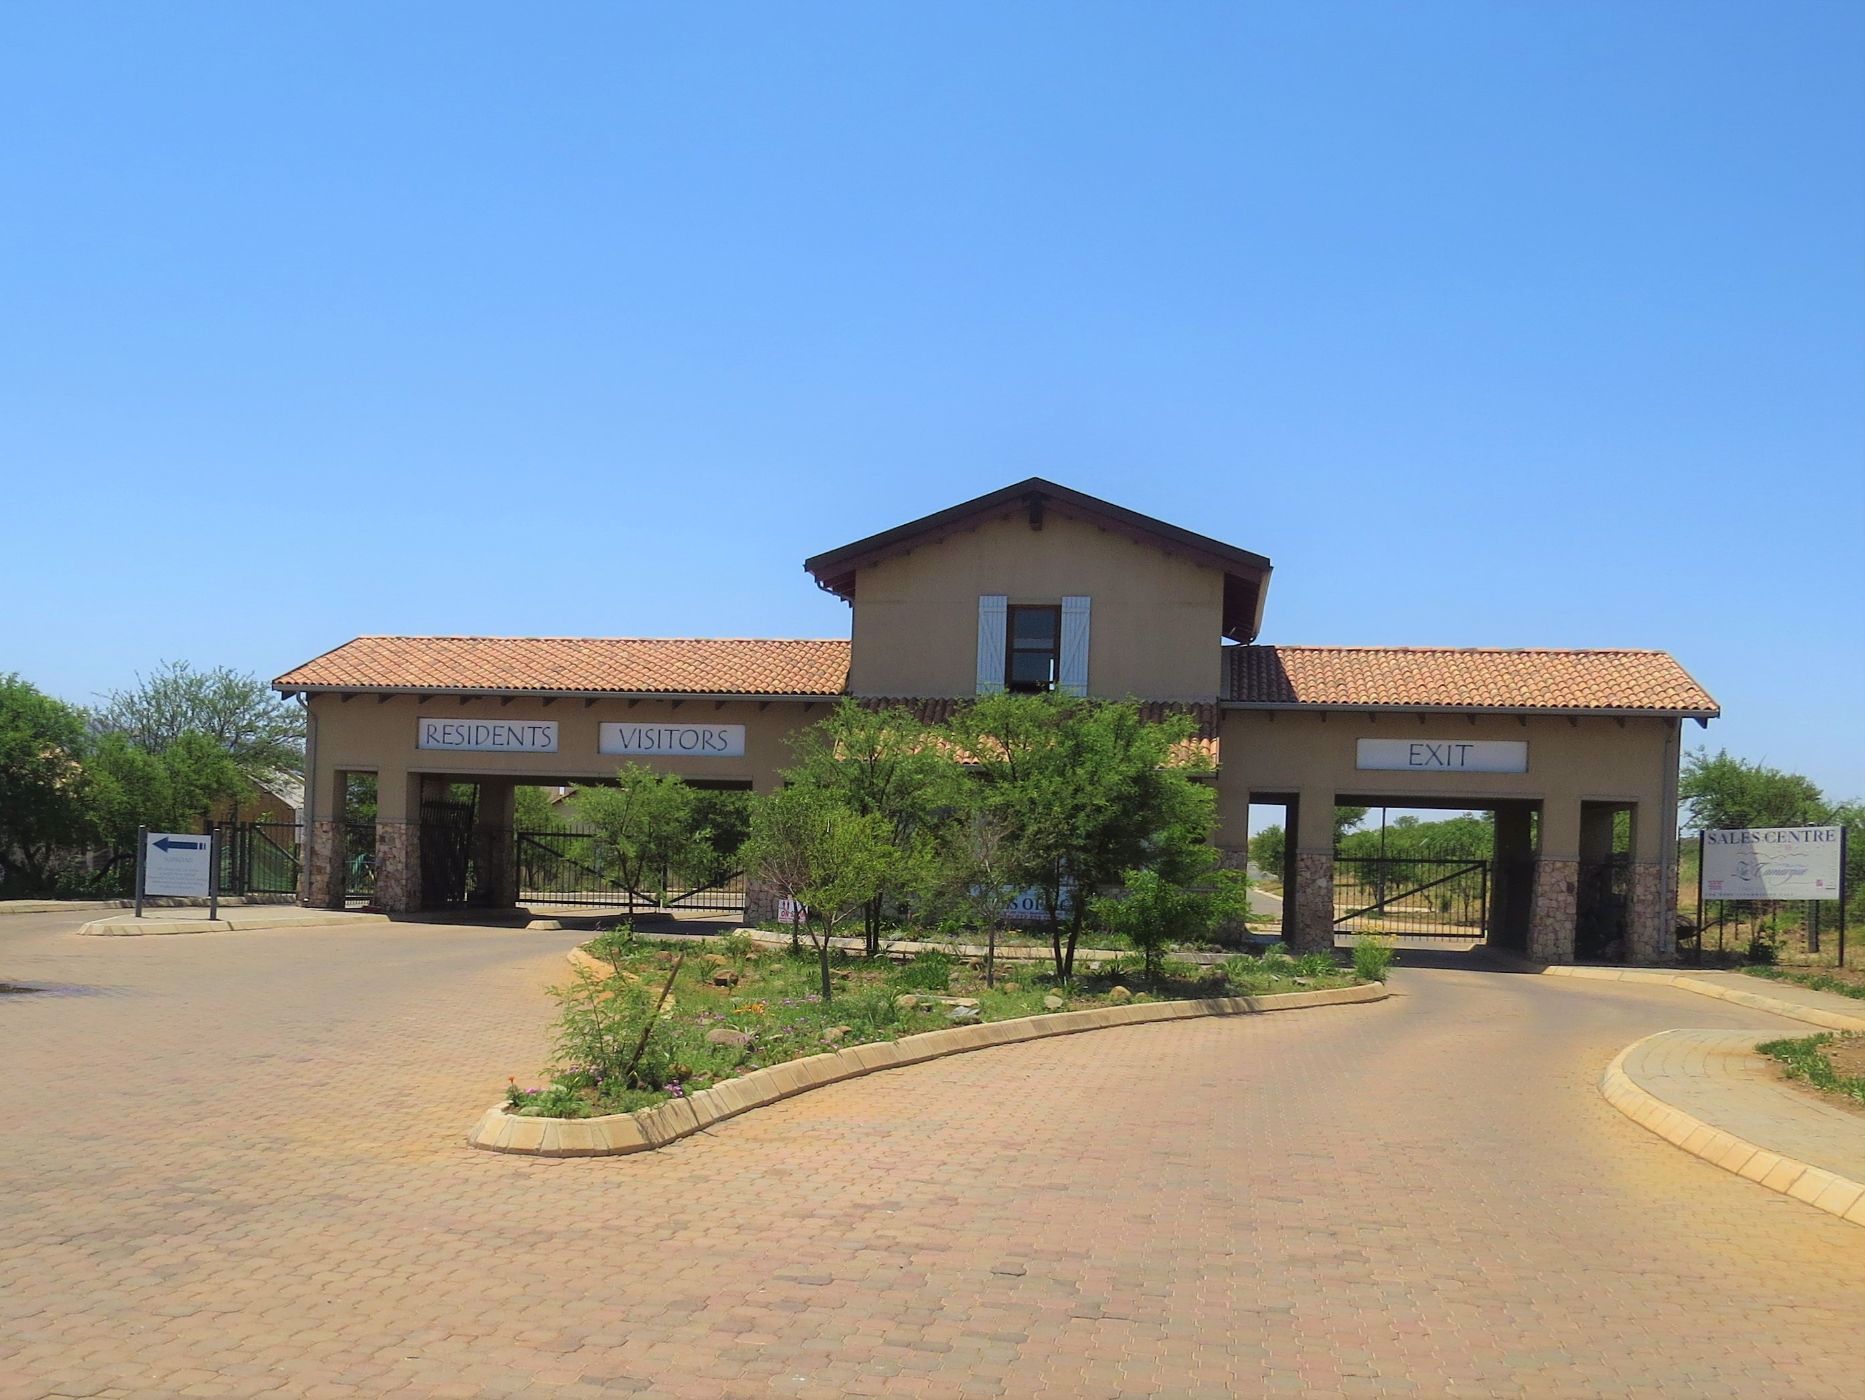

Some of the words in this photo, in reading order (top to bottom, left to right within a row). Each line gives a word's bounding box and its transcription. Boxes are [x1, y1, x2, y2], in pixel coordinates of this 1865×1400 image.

[426, 724, 552, 747] RESIDENTS
[619, 727, 729, 751] VISITORS
[1409, 743, 1474, 767] EXIT
[1708, 831, 1760, 845] SALES
[1764, 829, 1837, 844] CENTRE
